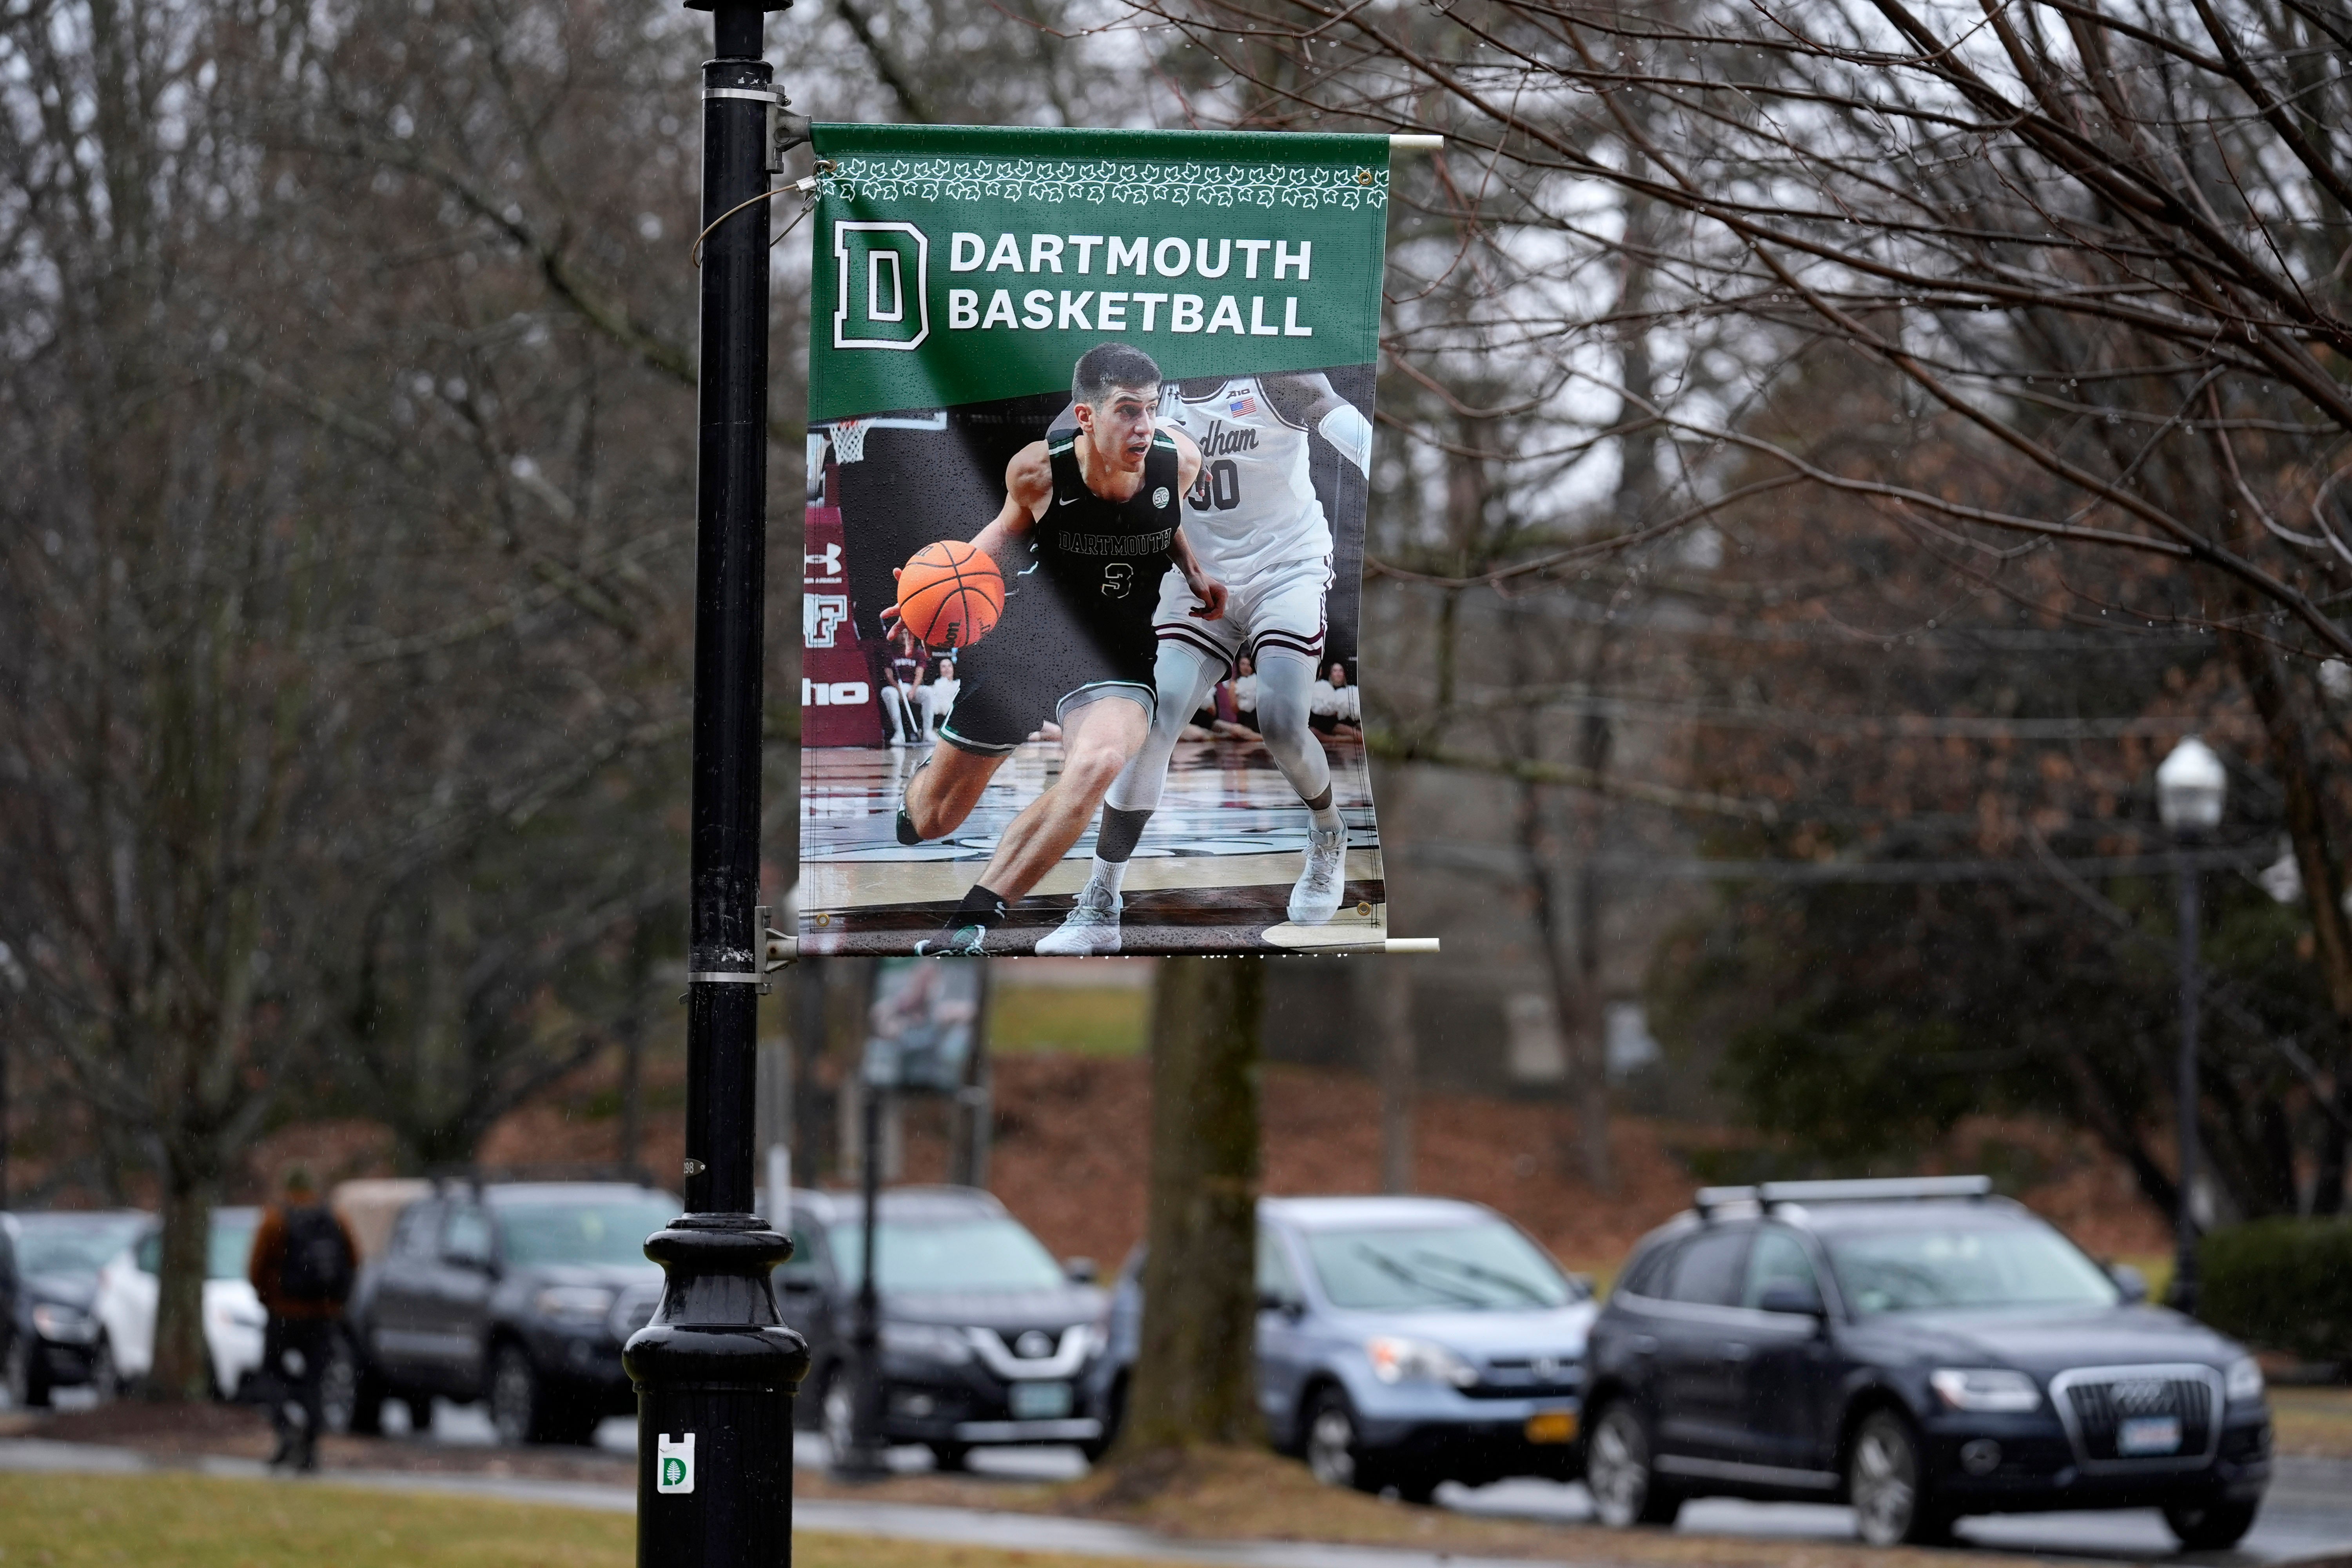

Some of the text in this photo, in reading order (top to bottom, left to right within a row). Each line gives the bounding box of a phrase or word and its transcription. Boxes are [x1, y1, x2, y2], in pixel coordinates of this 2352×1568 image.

[950, 232, 1311, 280] DARTMOUTH
[833, 219, 930, 350] D
[949, 289, 1312, 336] BASKETBALL
[1059, 528, 1172, 555] DARTMOUTH
[1102, 563, 1133, 599] 3
